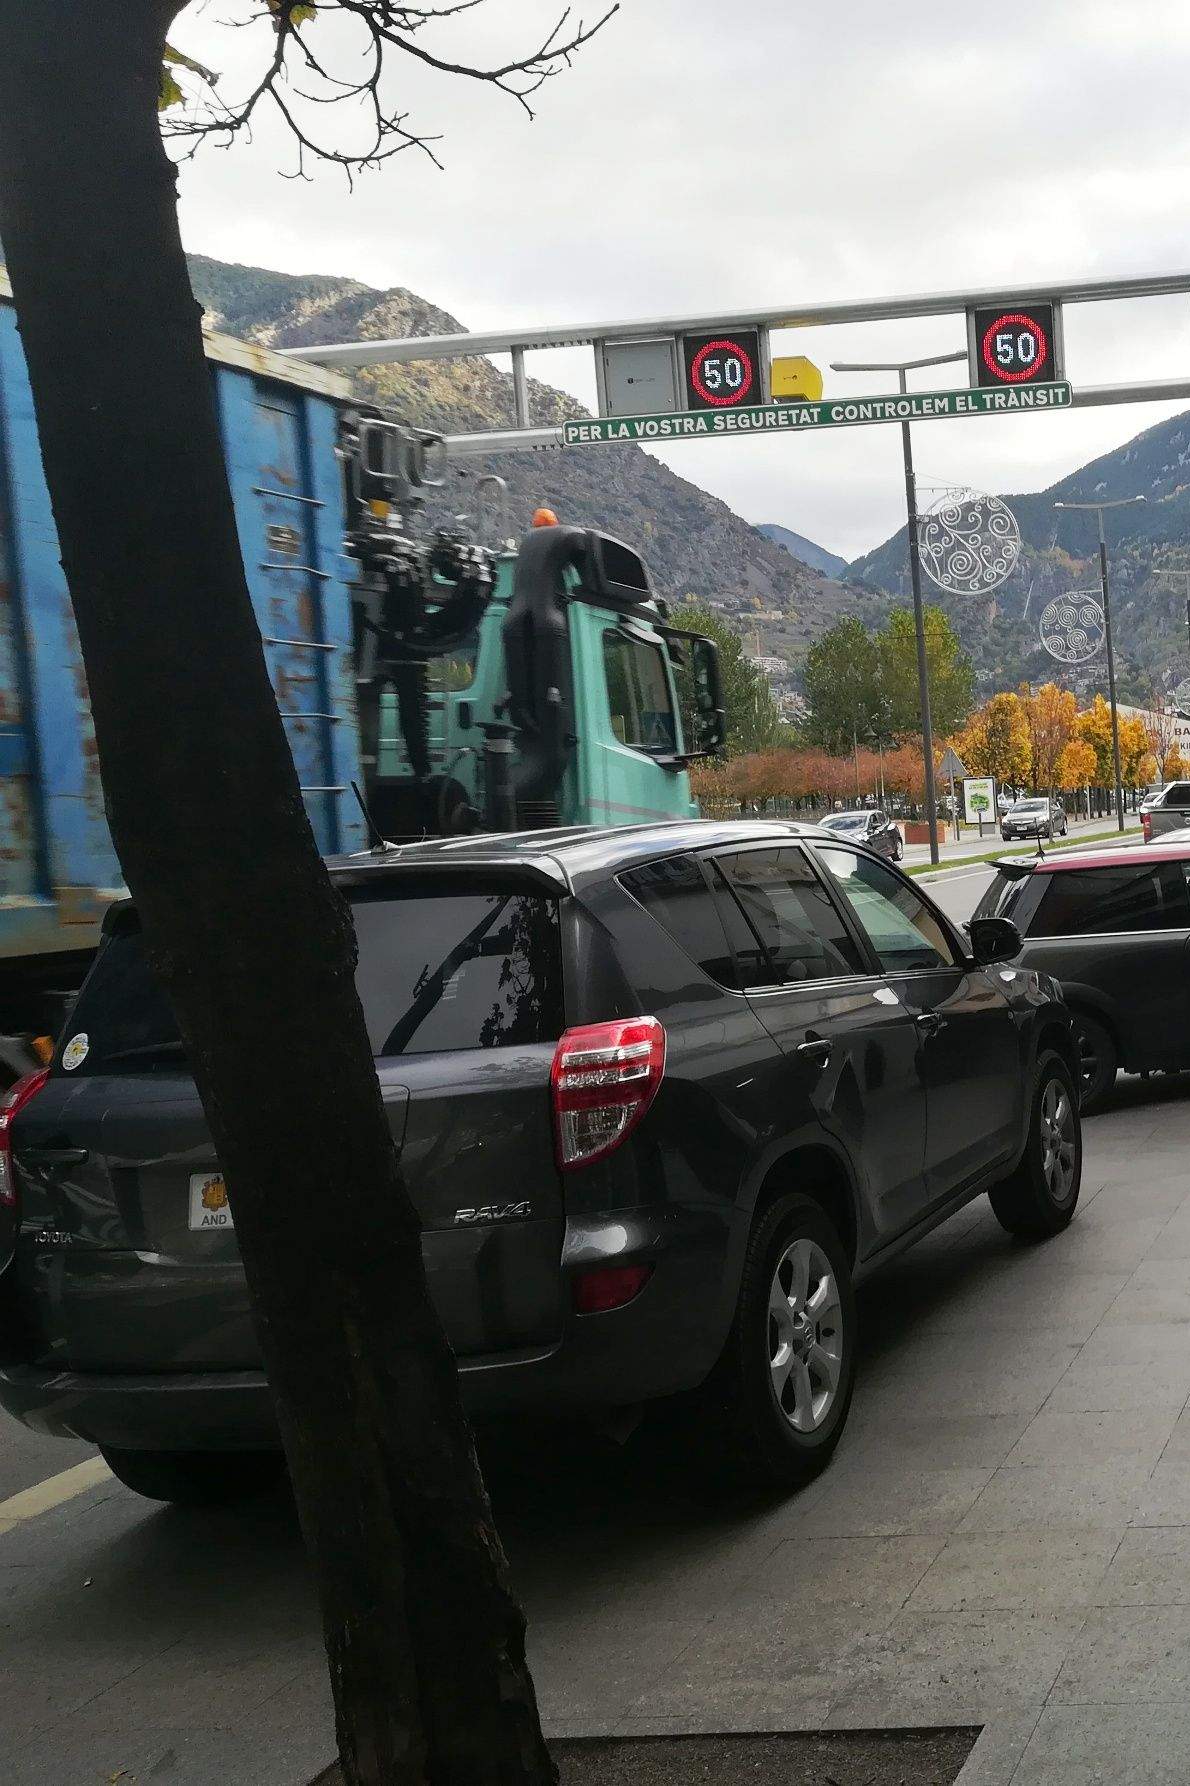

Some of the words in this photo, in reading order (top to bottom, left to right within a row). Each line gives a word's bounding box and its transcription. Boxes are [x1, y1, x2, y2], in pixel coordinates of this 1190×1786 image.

[997, 332, 1035, 364] 50
[704, 358, 742, 389] 50
[567, 424, 602, 443] PER
[607, 423, 630, 439] LA
[634, 417, 708, 436] VOSTRA
[713, 408, 821, 431] SEGURETAT
[831, 397, 949, 422] CONTROLEM
[956, 396, 978, 411] EL
[982, 388, 1066, 409] TRÀNSIT
[201, 1214, 228, 1226] AND
